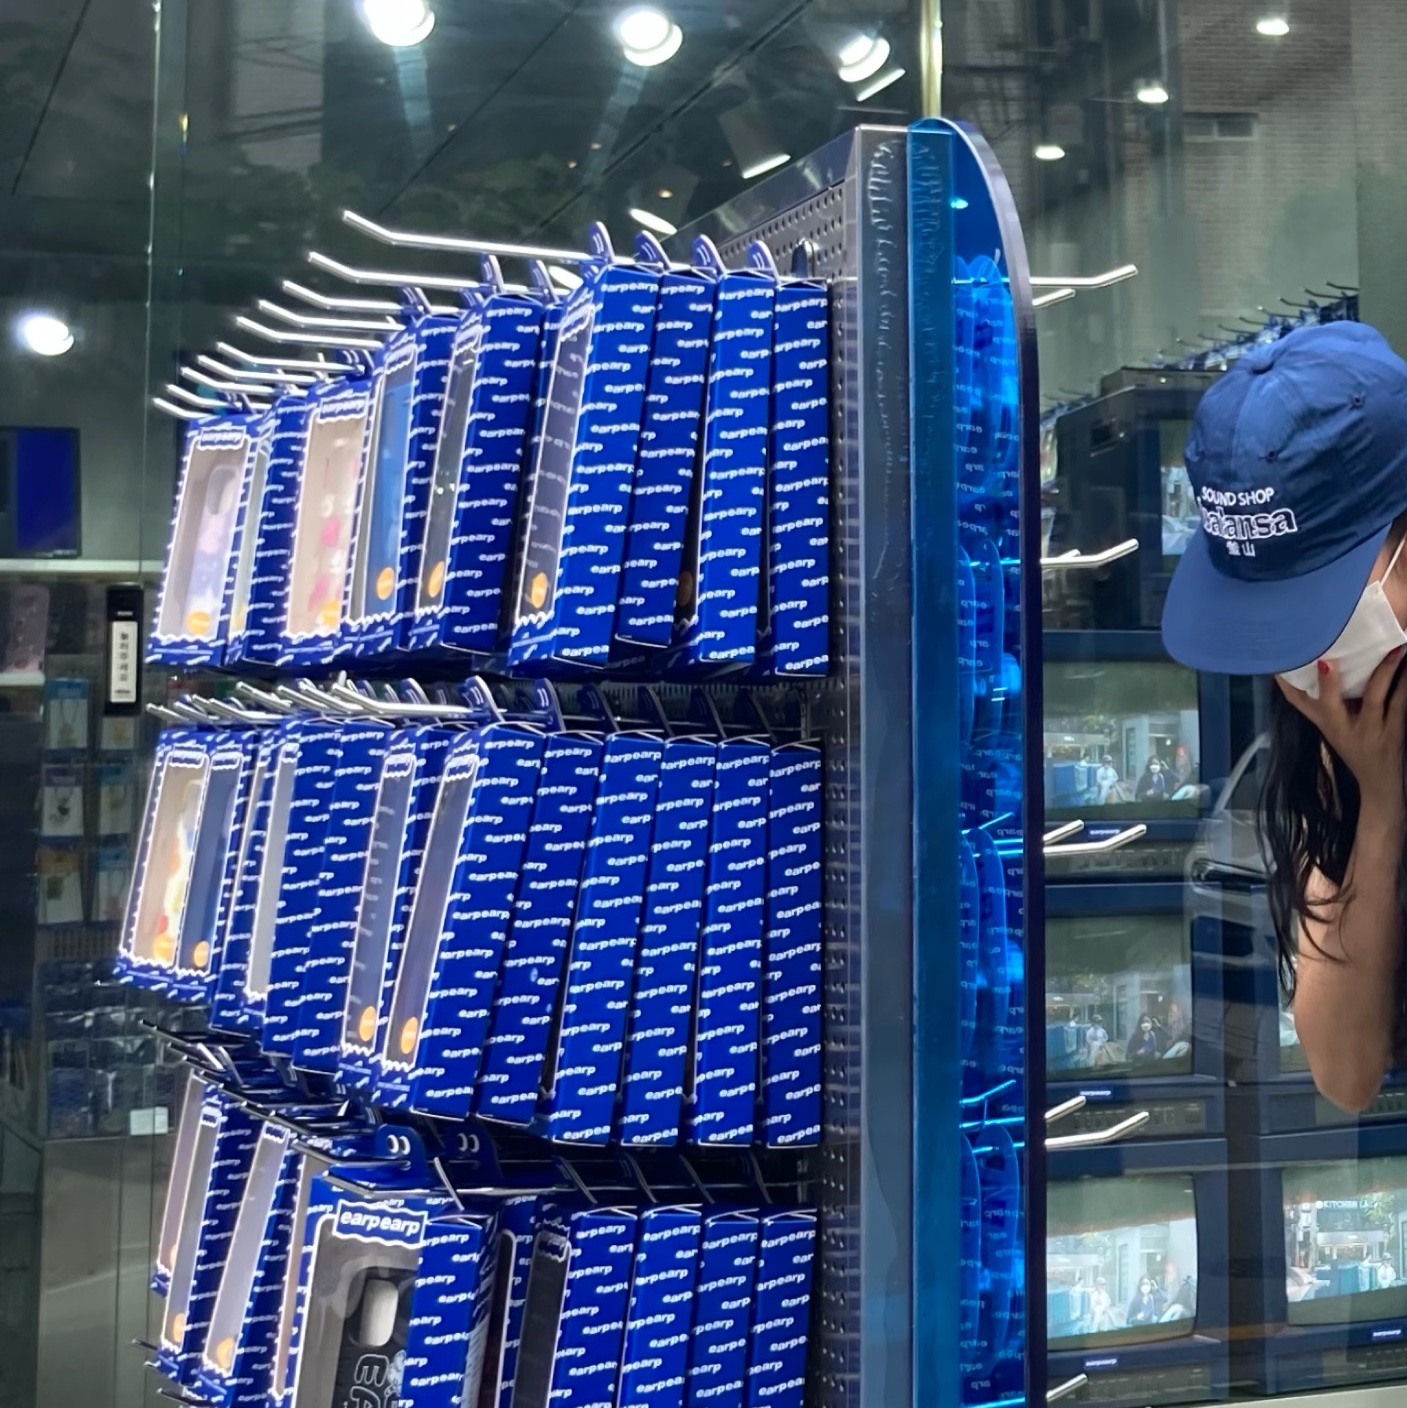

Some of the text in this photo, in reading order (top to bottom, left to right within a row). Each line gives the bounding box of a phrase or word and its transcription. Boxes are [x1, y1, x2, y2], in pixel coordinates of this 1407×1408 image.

[719, 288, 774, 300] earpearp
[591, 423, 640, 433] earpea
[640, 448, 695, 458] earpearp
[1202, 485, 1275, 506] SOUND SHOP
[452, 910, 510, 920] earpearp
[514, 918, 571, 928] earpearp
[340, 1210, 420, 1237] earpearp
[702, 1233, 757, 1249] earpearp
[761, 1230, 815, 1248] earpearp
[696, 1381, 742, 1397] earpea
